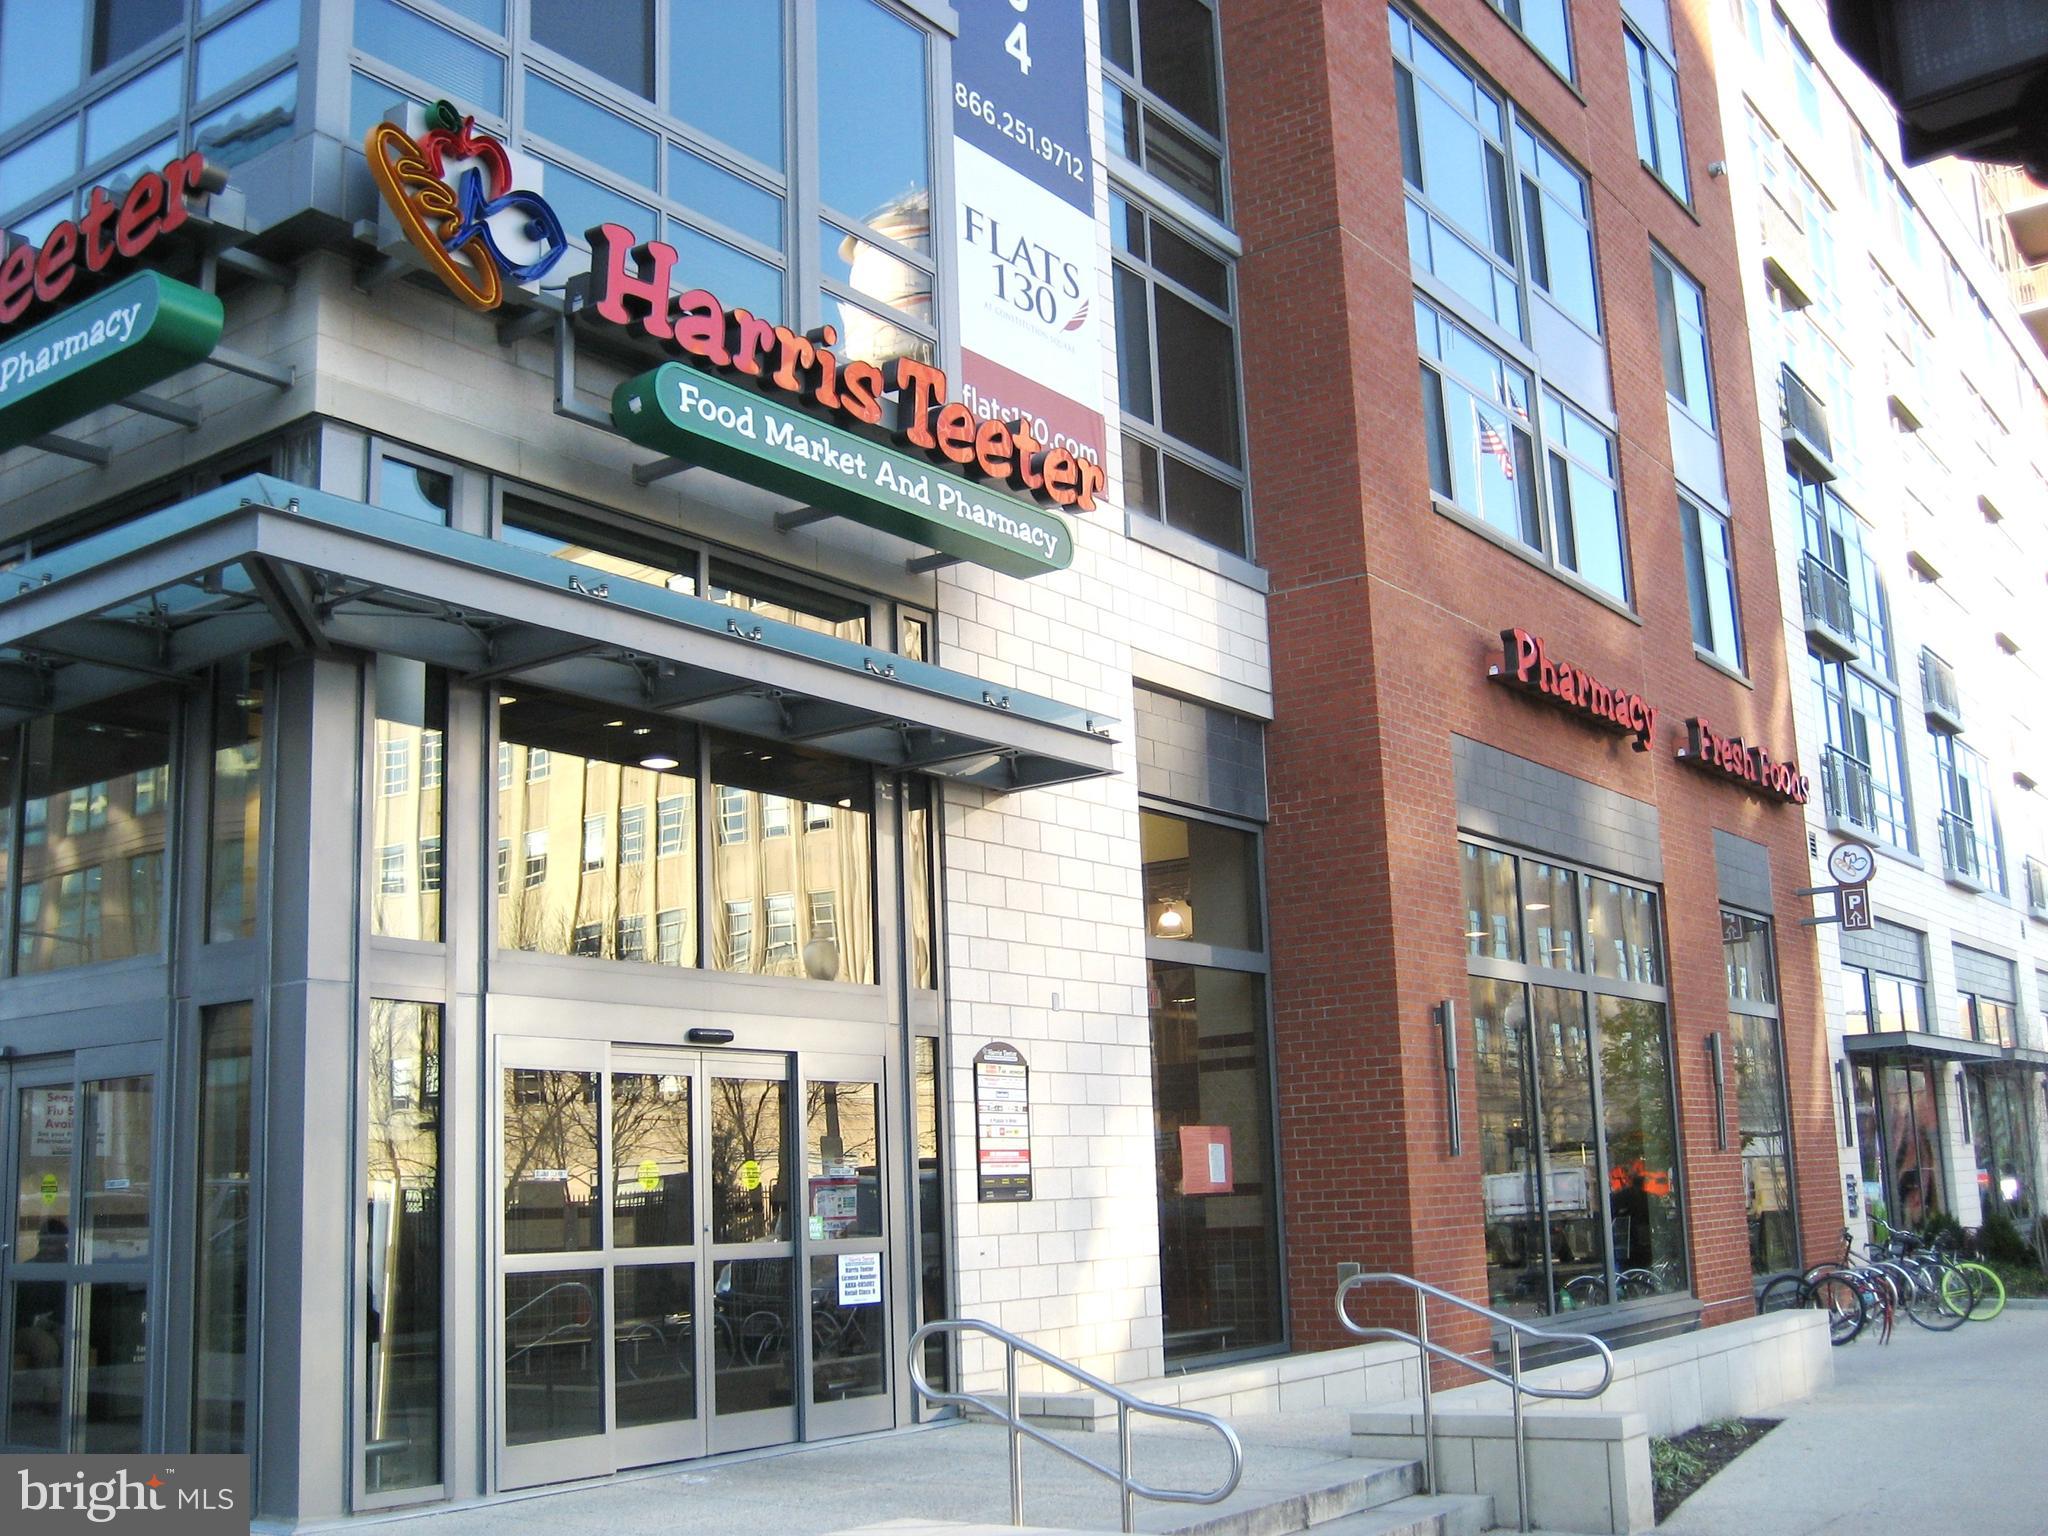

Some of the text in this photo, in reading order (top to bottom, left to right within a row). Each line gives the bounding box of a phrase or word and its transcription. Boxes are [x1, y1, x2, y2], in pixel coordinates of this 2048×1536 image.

[1005, 22, 1031, 75] 4
[955, 82, 1084, 182] 866.251.9712
[0, 152, 204, 323] eeter
[962, 203, 1080, 299] FLATS
[992, 264, 1057, 324] 130
[0, 303, 142, 391] Pharmacy
[597, 223, 1104, 512] Harris Teeter
[678, 382, 1058, 558] Food Market And Pharmacy
[1513, 628, 1659, 750] Pharmacy
[1697, 719, 1810, 804] Fresh Foods
[1849, 895, 1860, 909] P
[45, 1119, 74, 1128] Avai
[48, 1092, 75, 1103] Seas
